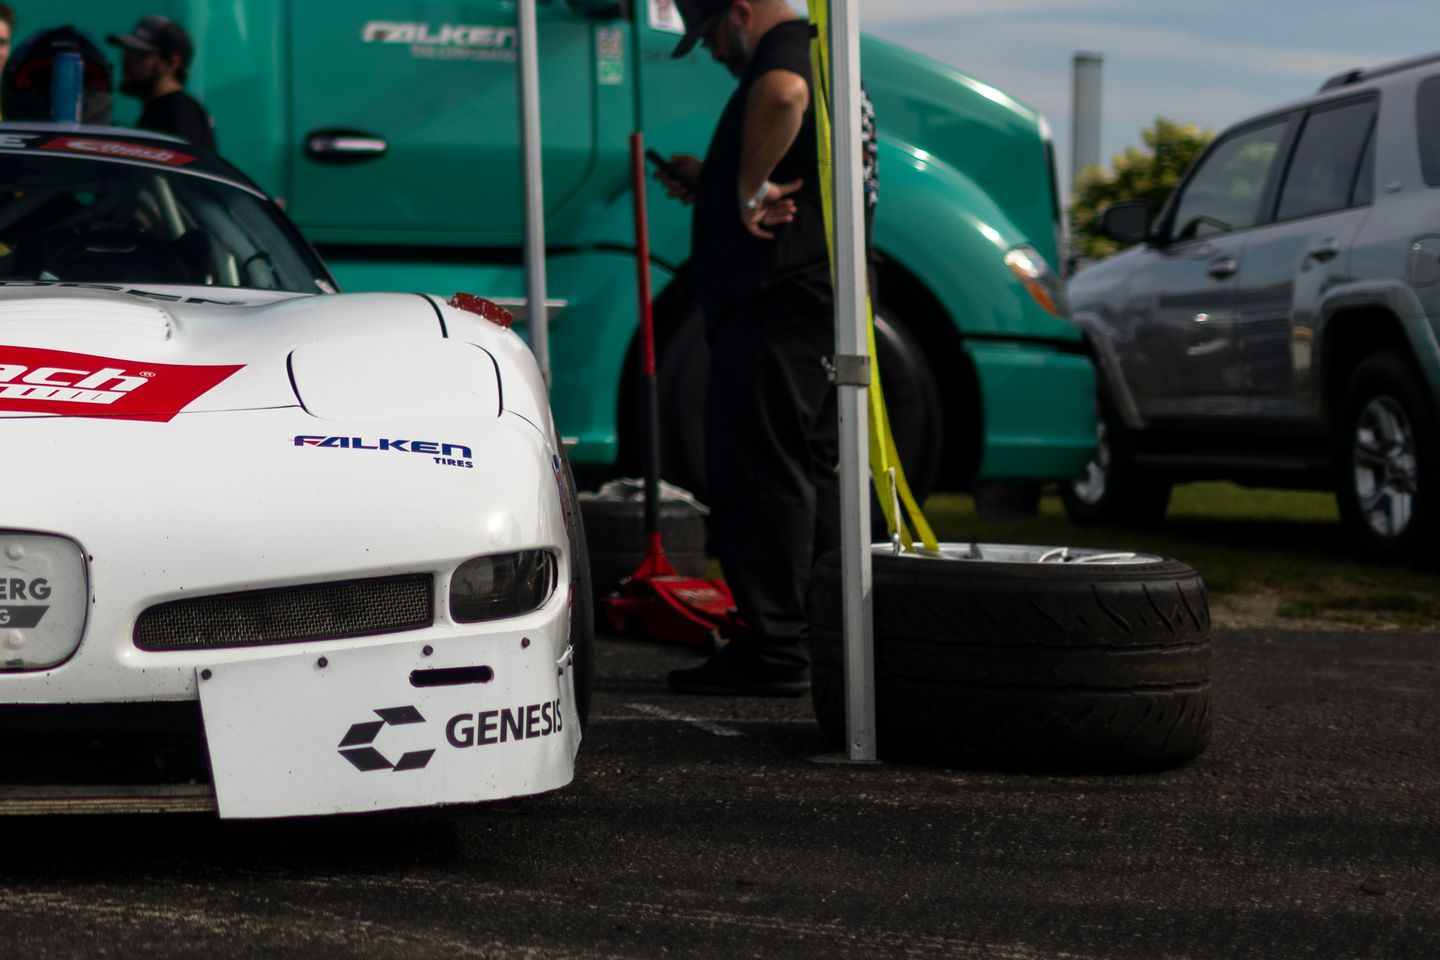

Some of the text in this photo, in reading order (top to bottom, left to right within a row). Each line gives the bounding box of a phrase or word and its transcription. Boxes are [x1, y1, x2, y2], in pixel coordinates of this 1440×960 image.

[363, 20, 517, 49] FALKEN
[293, 435, 472, 459] FALKEN
[433, 457, 474, 468] TIRES
[445, 697, 563, 749] GENESIS
